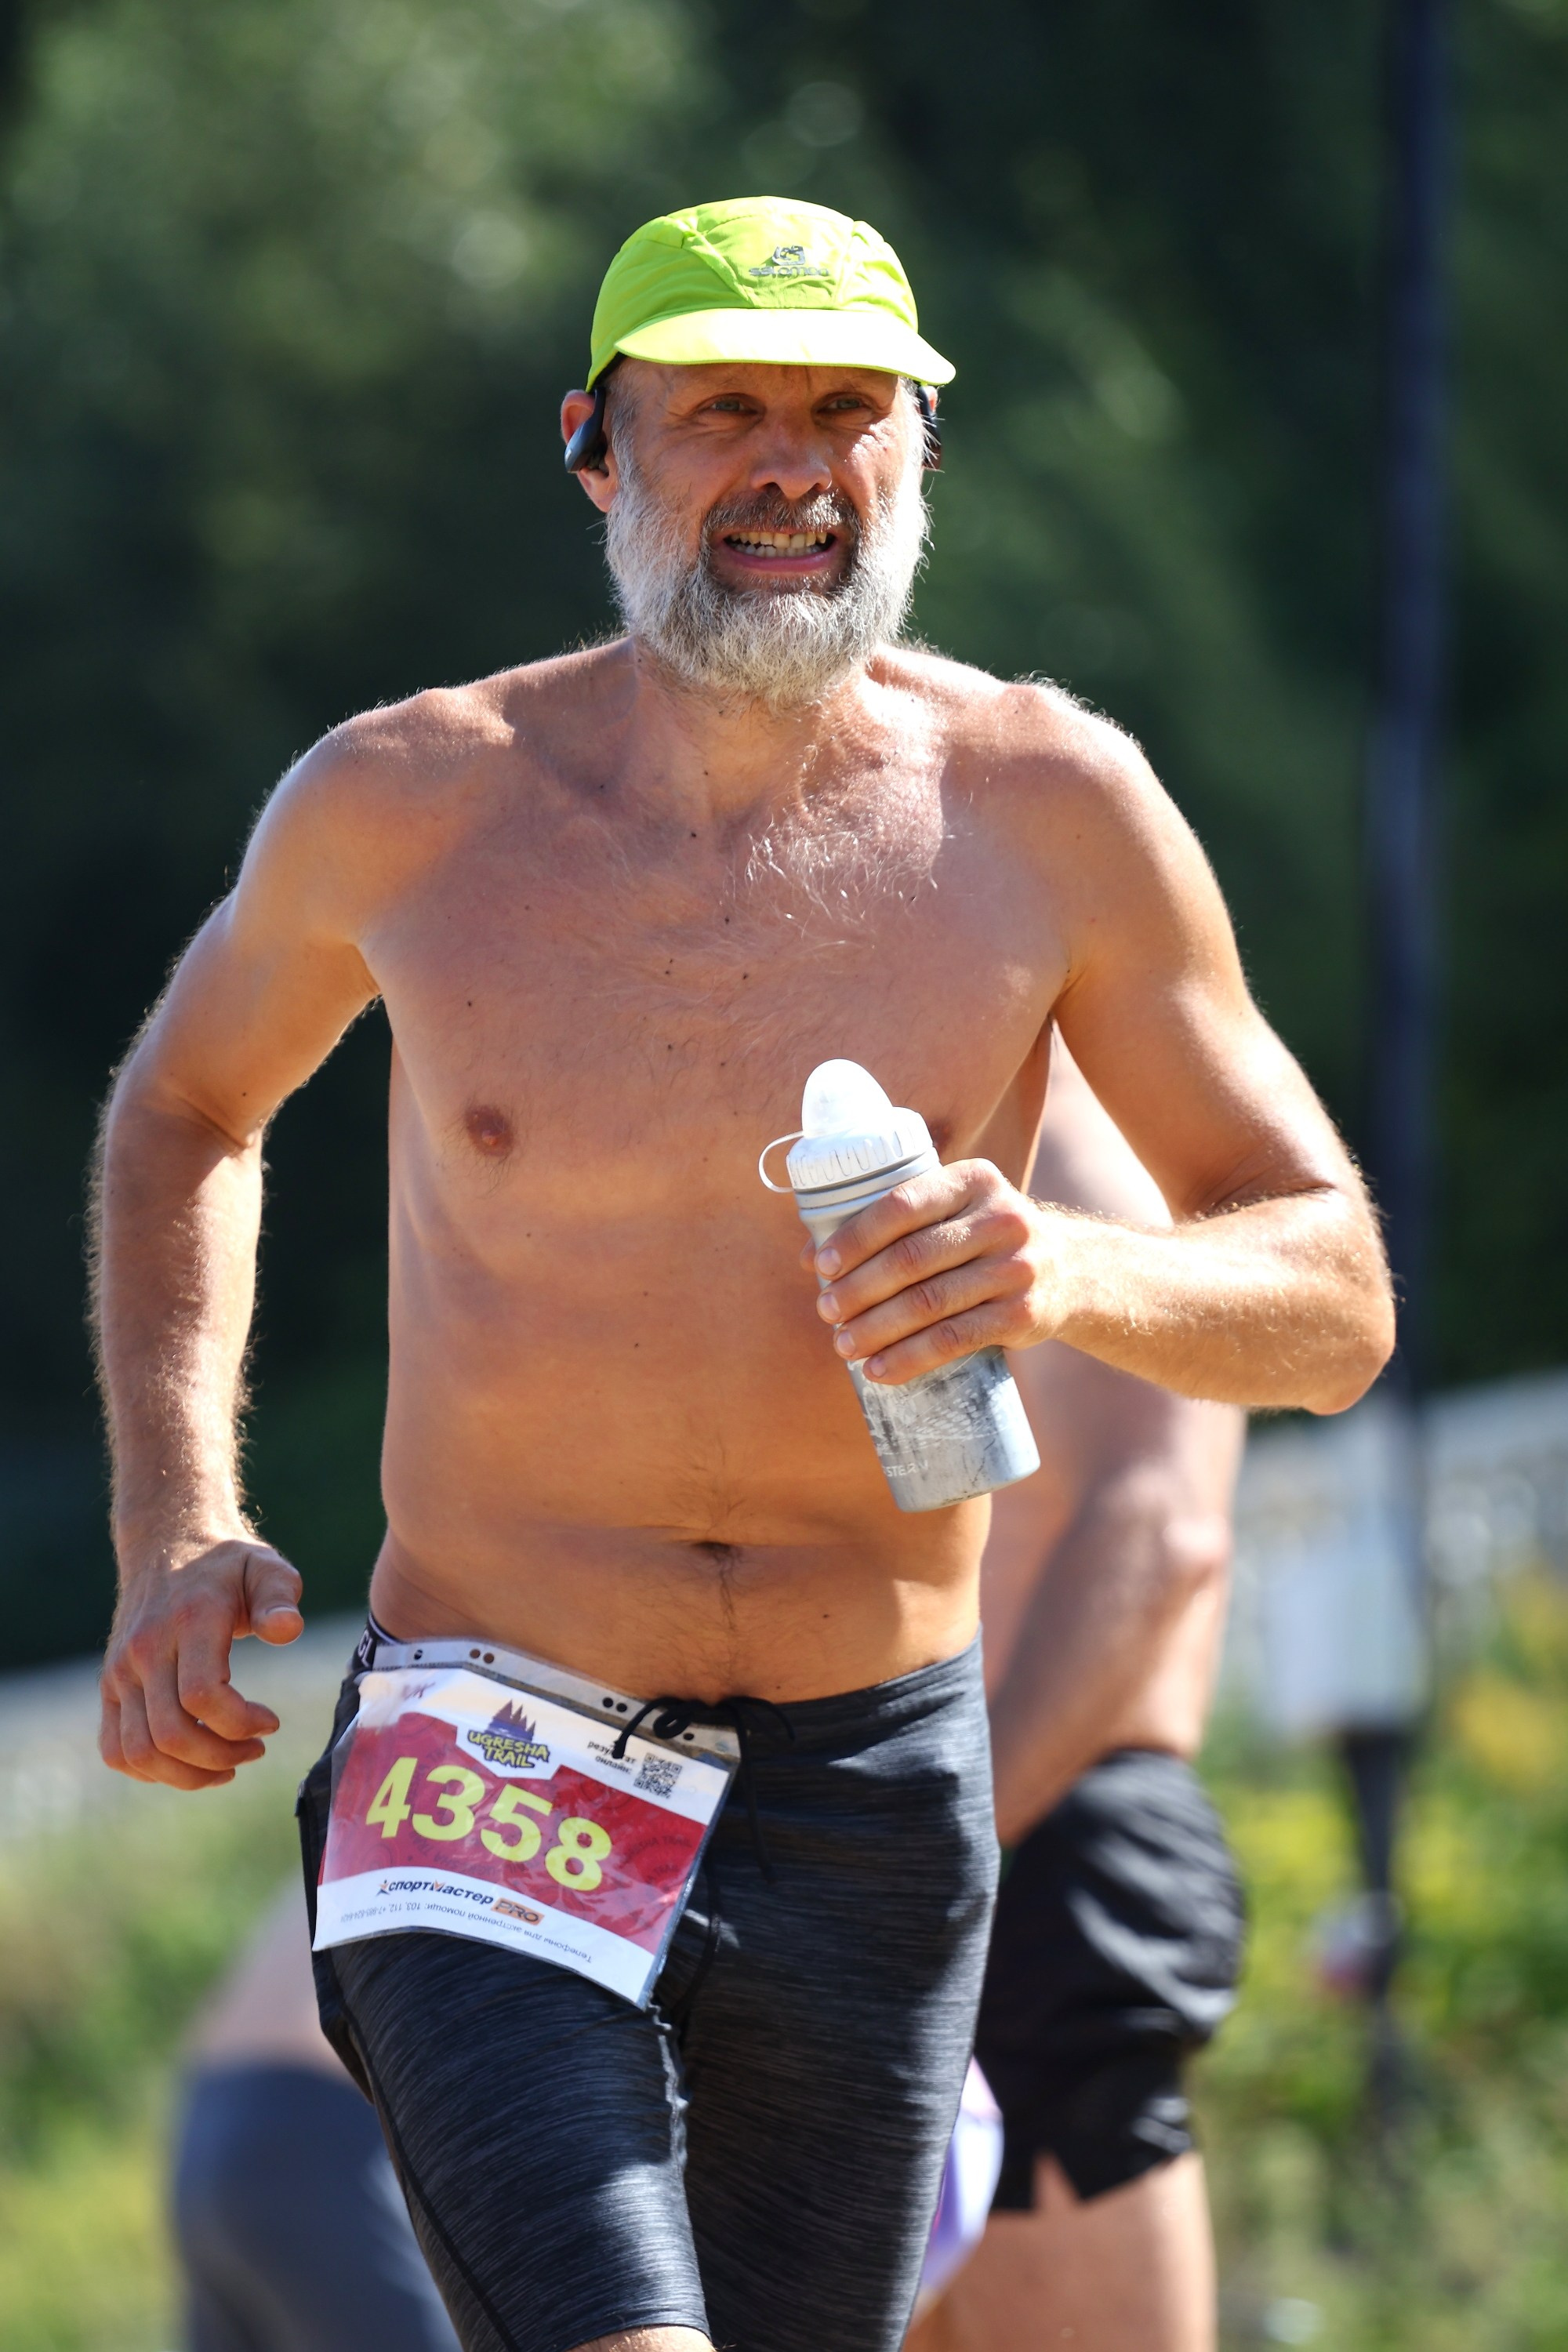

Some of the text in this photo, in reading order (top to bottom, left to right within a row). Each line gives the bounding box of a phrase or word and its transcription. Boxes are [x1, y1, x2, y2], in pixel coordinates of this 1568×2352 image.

[467, 1730, 550, 1762] UGRESHA
[484, 1745, 535, 1769] TRAIL
[587, 1741, 637, 1764] резуат
[365, 1757, 613, 1892] 4358
[467, 1911, 522, 1933] экстренной
[495, 1900, 540, 1924] PRO
[523, 1929, 543, 1942] для
[543, 1936, 593, 1964] Телефоны
